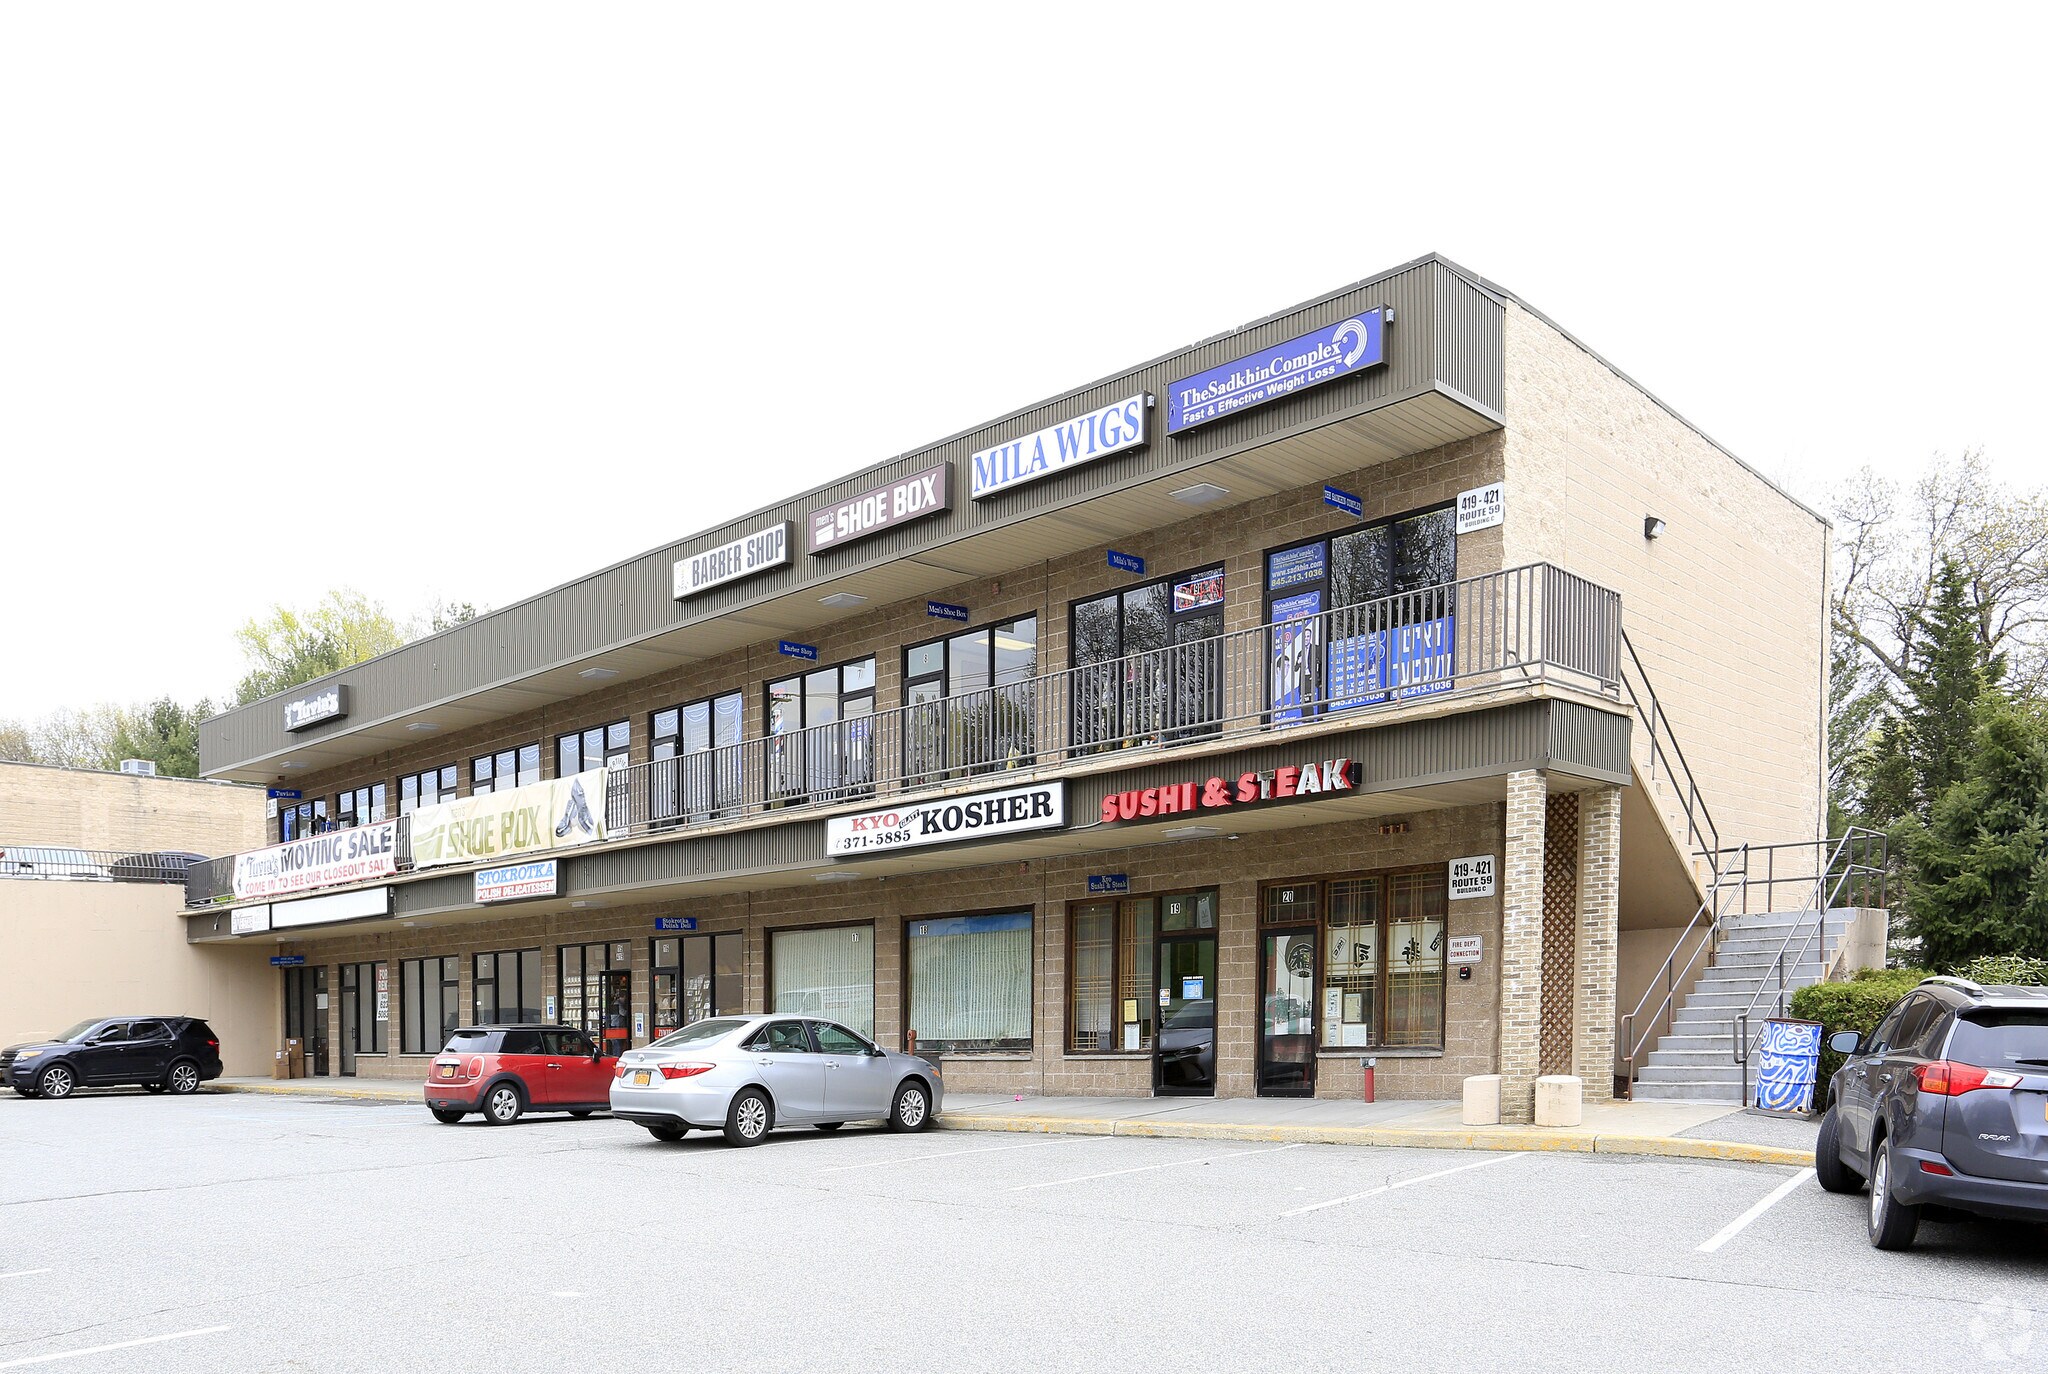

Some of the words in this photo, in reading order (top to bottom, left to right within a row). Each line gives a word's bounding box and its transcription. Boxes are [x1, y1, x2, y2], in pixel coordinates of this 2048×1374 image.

[1183, 404, 1206, 425] Fast
[1207, 404, 1215, 416] &
[1218, 390, 1264, 413] Effective
[1266, 377, 1306, 397] Weight
[1308, 365, 1335, 382] Loss
[973, 434, 1049, 493] MILA
[1054, 400, 1140, 463] WIGS
[836, 491, 888, 539] SHOE
[893, 472, 937, 519] BOX
[1461, 494, 1477, 511] 419
[1483, 488, 1499, 505] 421
[815, 510, 835, 528] men's
[1459, 507, 1487, 522] ROUTE
[1488, 504, 1501, 515] 59
[1464, 516, 1490, 528] BUILDING
[692, 544, 742, 588] BARBER
[746, 528, 784, 569] SHOP
[1271, 567, 1324, 588] 845.213.1036
[928, 604, 944, 615] Men's
[943, 607, 957, 617] Shoe
[956, 609, 967, 618] Box
[923, 652, 929, 664] 8
[1391, 679, 1453, 699] 85.213.1036
[1101, 781, 1197, 823] SUSHI
[1201, 776, 1232, 808] &
[1235, 758, 1352, 804] STEAK
[851, 813, 900, 833] KYO
[920, 790, 1054, 836] KOSHER
[446, 814, 495, 858] SHOE
[501, 804, 542, 851] BOX
[843, 829, 911, 850] 371-5885
[280, 834, 343, 873] MOVING
[347, 825, 392, 860] SALE
[245, 883, 266, 894] COME
[278, 877, 289, 889] TO
[290, 874, 304, 887] SEE
[305, 871, 321, 884] OUR
[323, 861, 366, 881] CLOSEOUT
[477, 863, 554, 886] STOKROTKA
[1453, 862, 1469, 878] 419
[1475, 860, 1491, 875] 421
[477, 889, 501, 900] POLISH
[503, 882, 554, 897] DELICATESSEN
[1452, 877, 1479, 889] ROUTE
[1480, 875, 1493, 885] 59
[1456, 887, 1482, 895] BUILDING
[1283, 891, 1294, 902] 20
[1170, 902, 1180, 914] 19
[1450, 949, 1480, 958] CONNECTION
